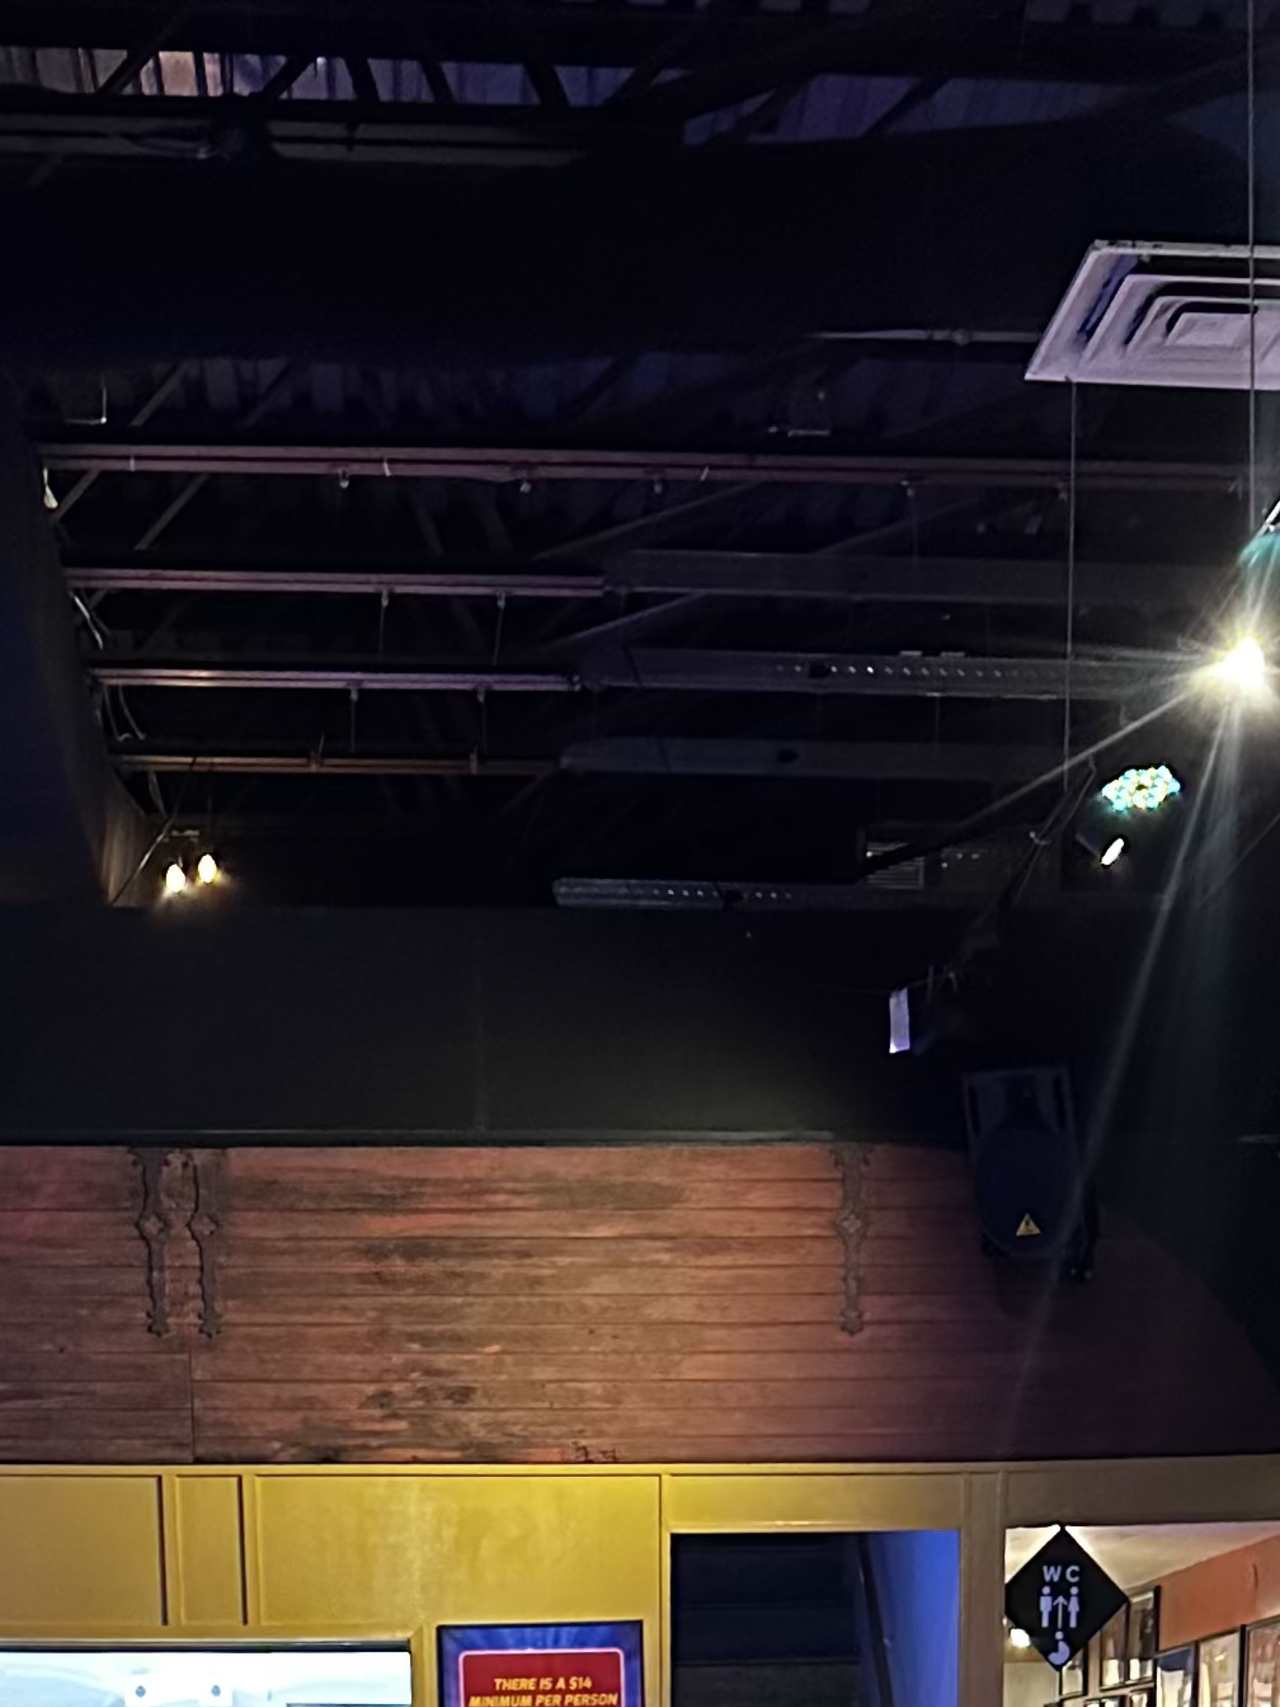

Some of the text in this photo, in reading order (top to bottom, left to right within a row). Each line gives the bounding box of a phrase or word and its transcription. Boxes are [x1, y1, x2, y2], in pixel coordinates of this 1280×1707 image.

[493, 1677, 538, 1691] THERE
[539, 1677, 553, 1690] IS
[555, 1676, 566, 1690] A
[468, 1692, 619, 1707] MINIMUM PER PERSON
